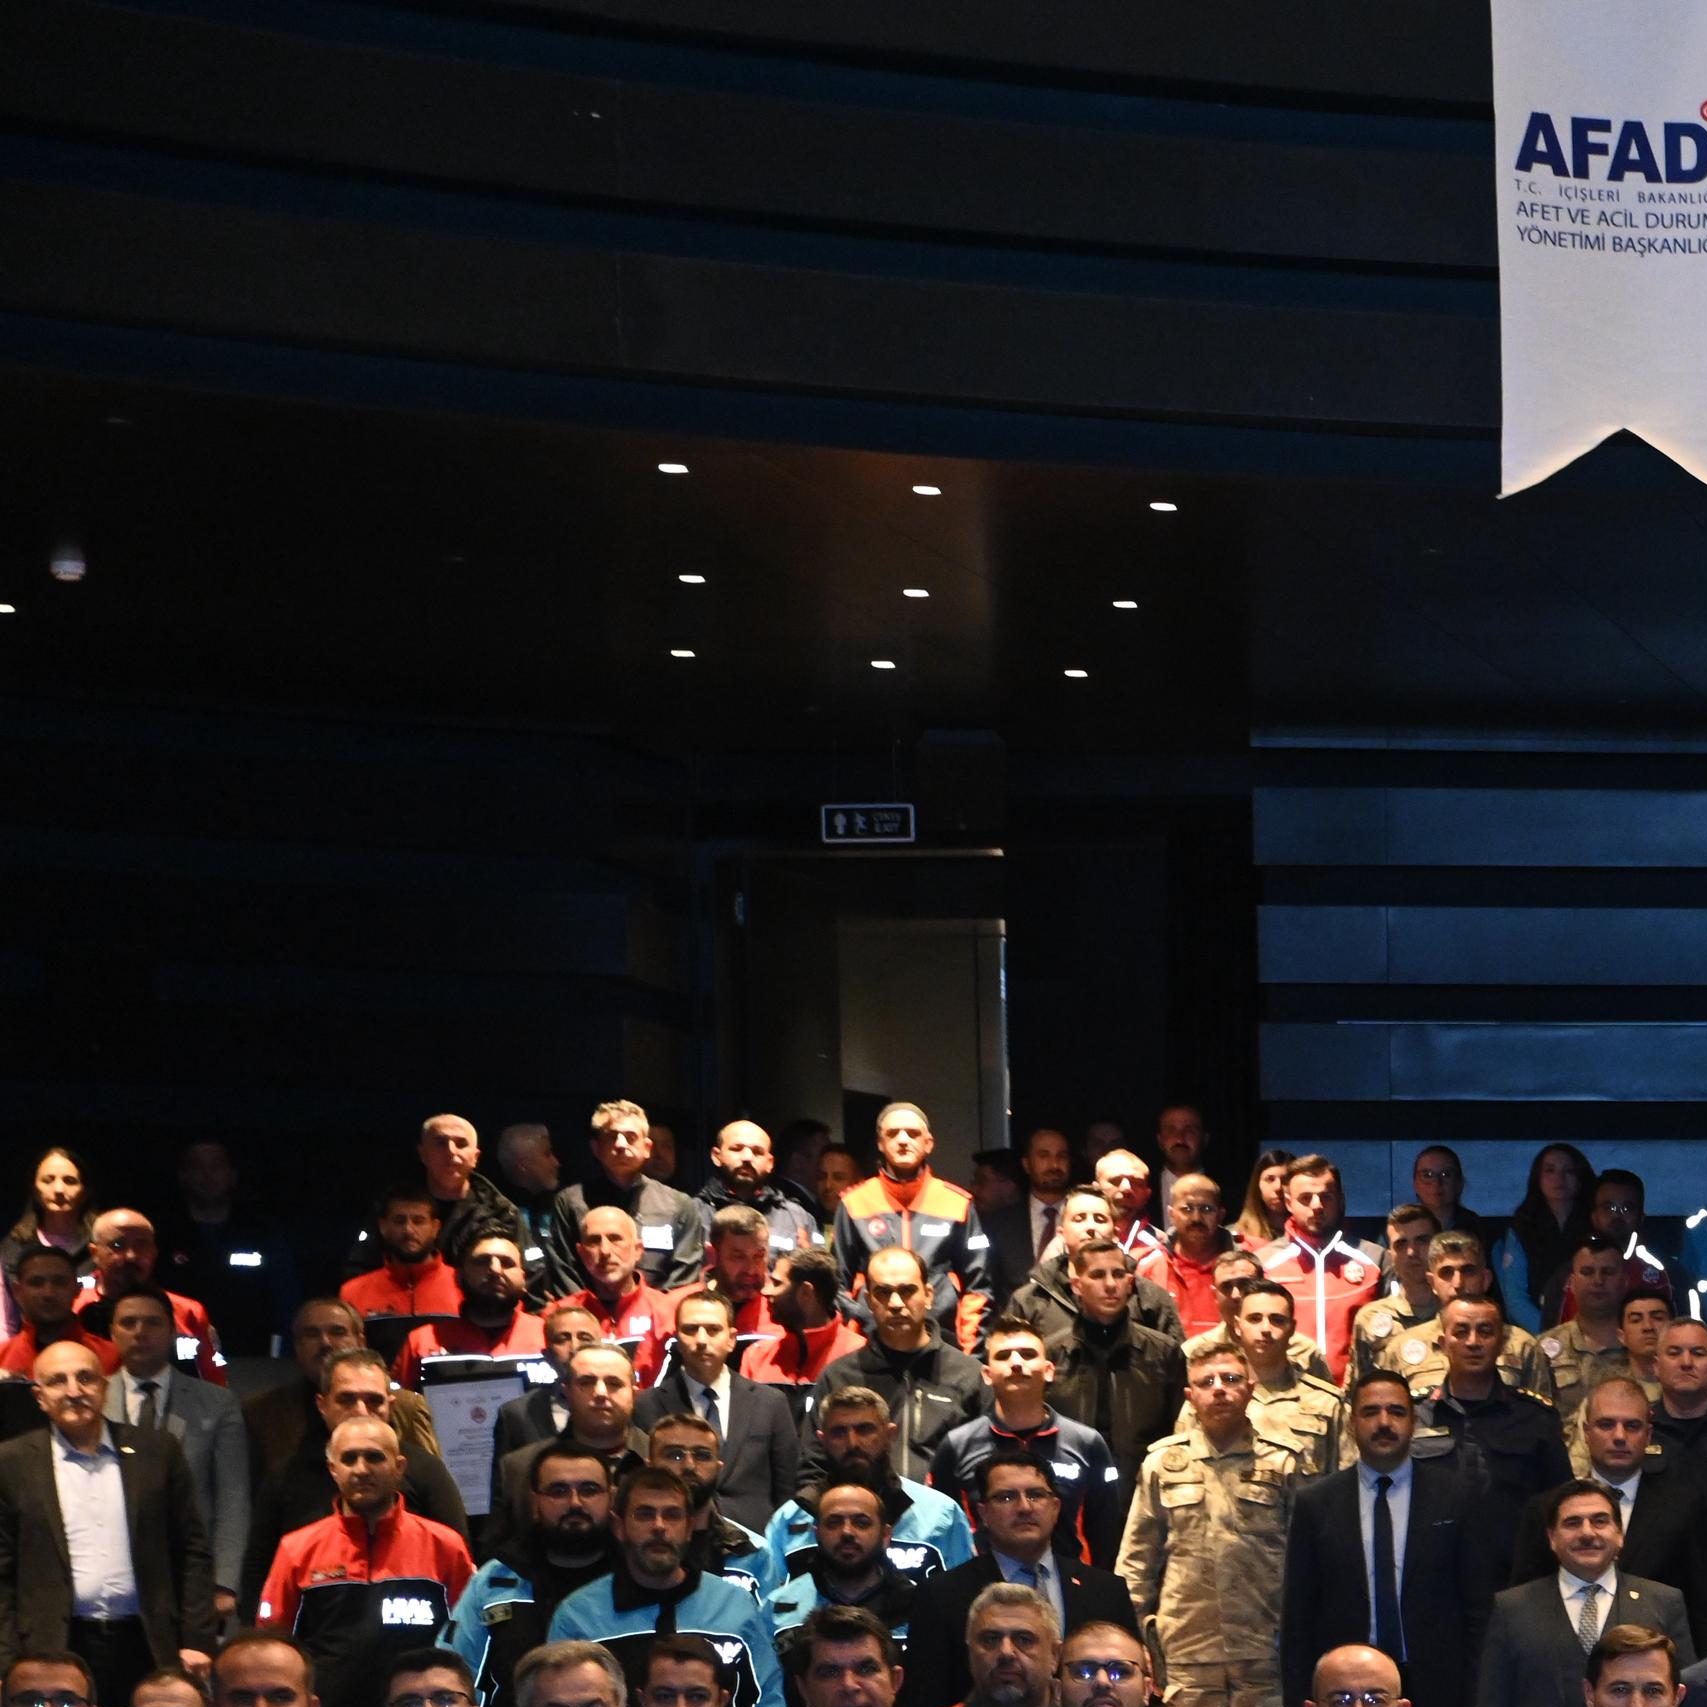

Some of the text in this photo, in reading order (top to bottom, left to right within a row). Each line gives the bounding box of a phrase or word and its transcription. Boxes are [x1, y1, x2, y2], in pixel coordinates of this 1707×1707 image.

[1514, 178, 1542, 195] T.C.
[1558, 183, 1620, 203] İÇİŞLERİ
[1516, 201, 1563, 221] AFET
[1567, 207, 1591, 225] VE
[1596, 208, 1639, 228] ACİL
[1516, 225, 1605, 251] YÖNETİMİ
